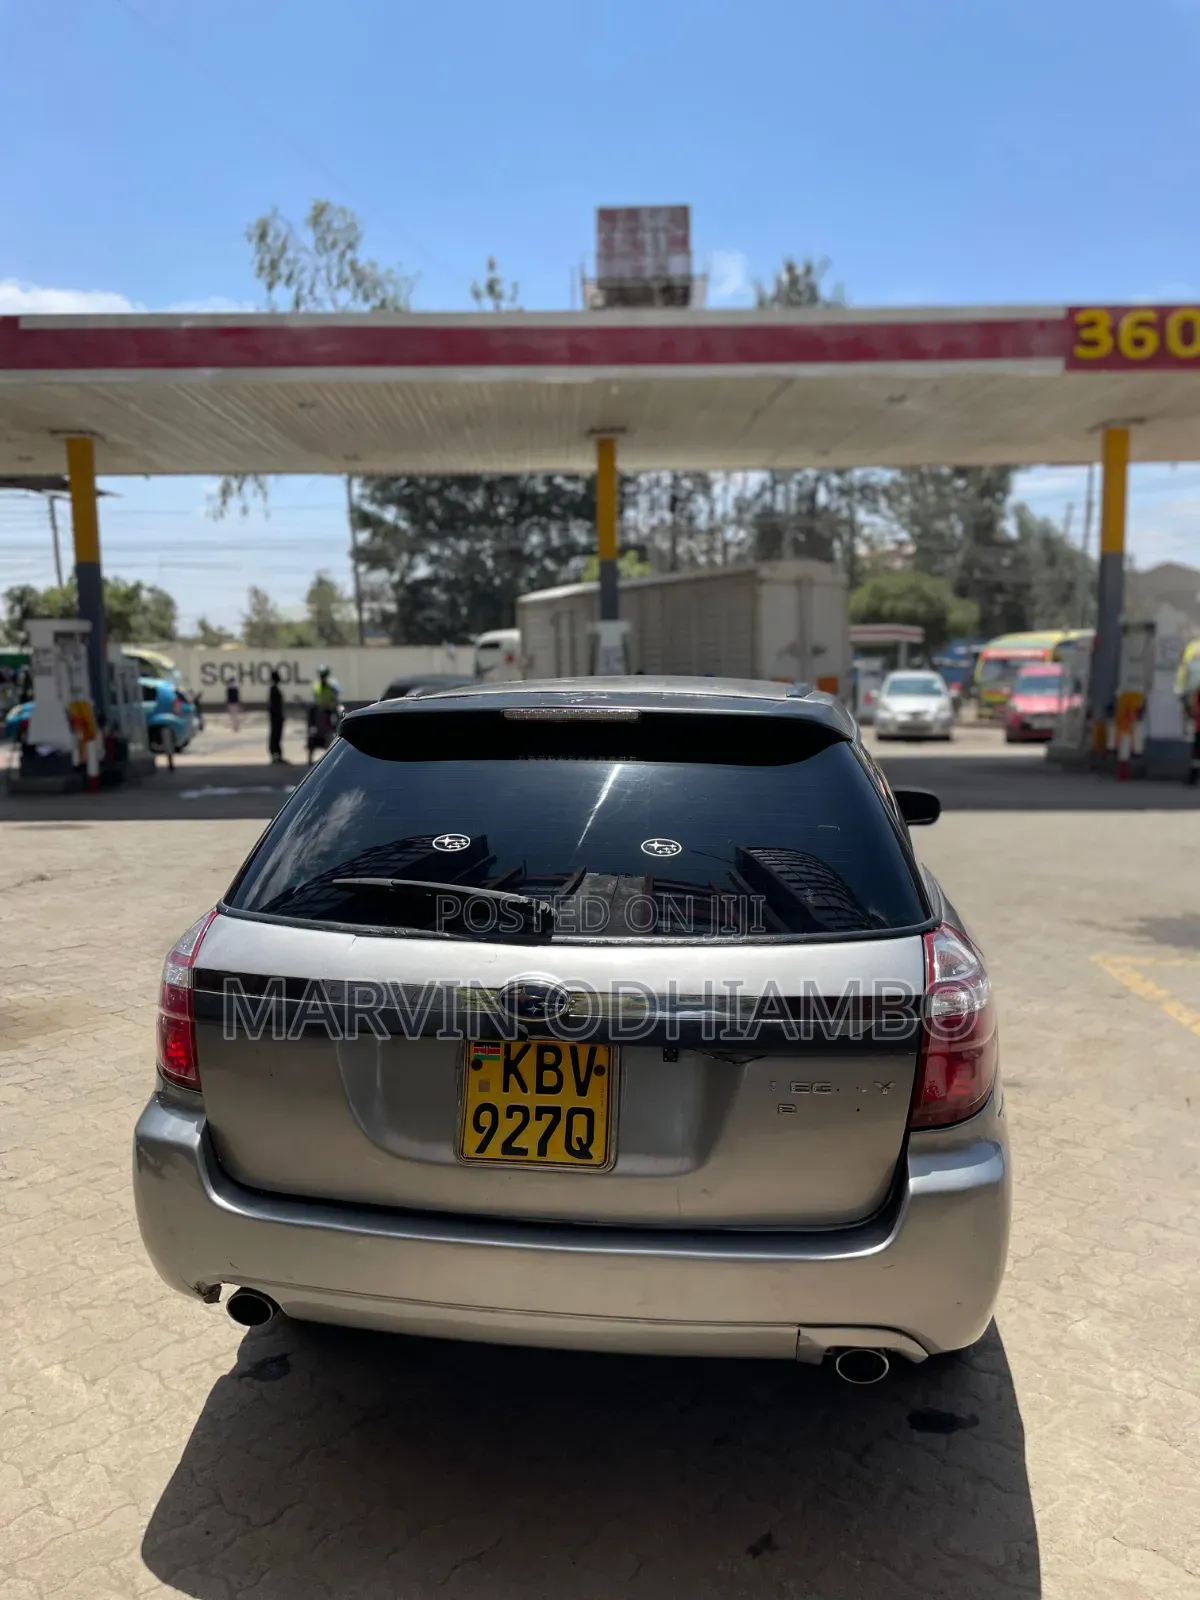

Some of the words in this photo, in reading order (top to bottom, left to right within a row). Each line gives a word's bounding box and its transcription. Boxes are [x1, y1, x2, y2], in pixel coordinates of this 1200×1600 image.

[1073, 306, 1200, 360] 360
[200, 660, 312, 686] SCHOOL
[502, 1043, 598, 1097] KBV
[472, 1102, 595, 1160] 927Q
